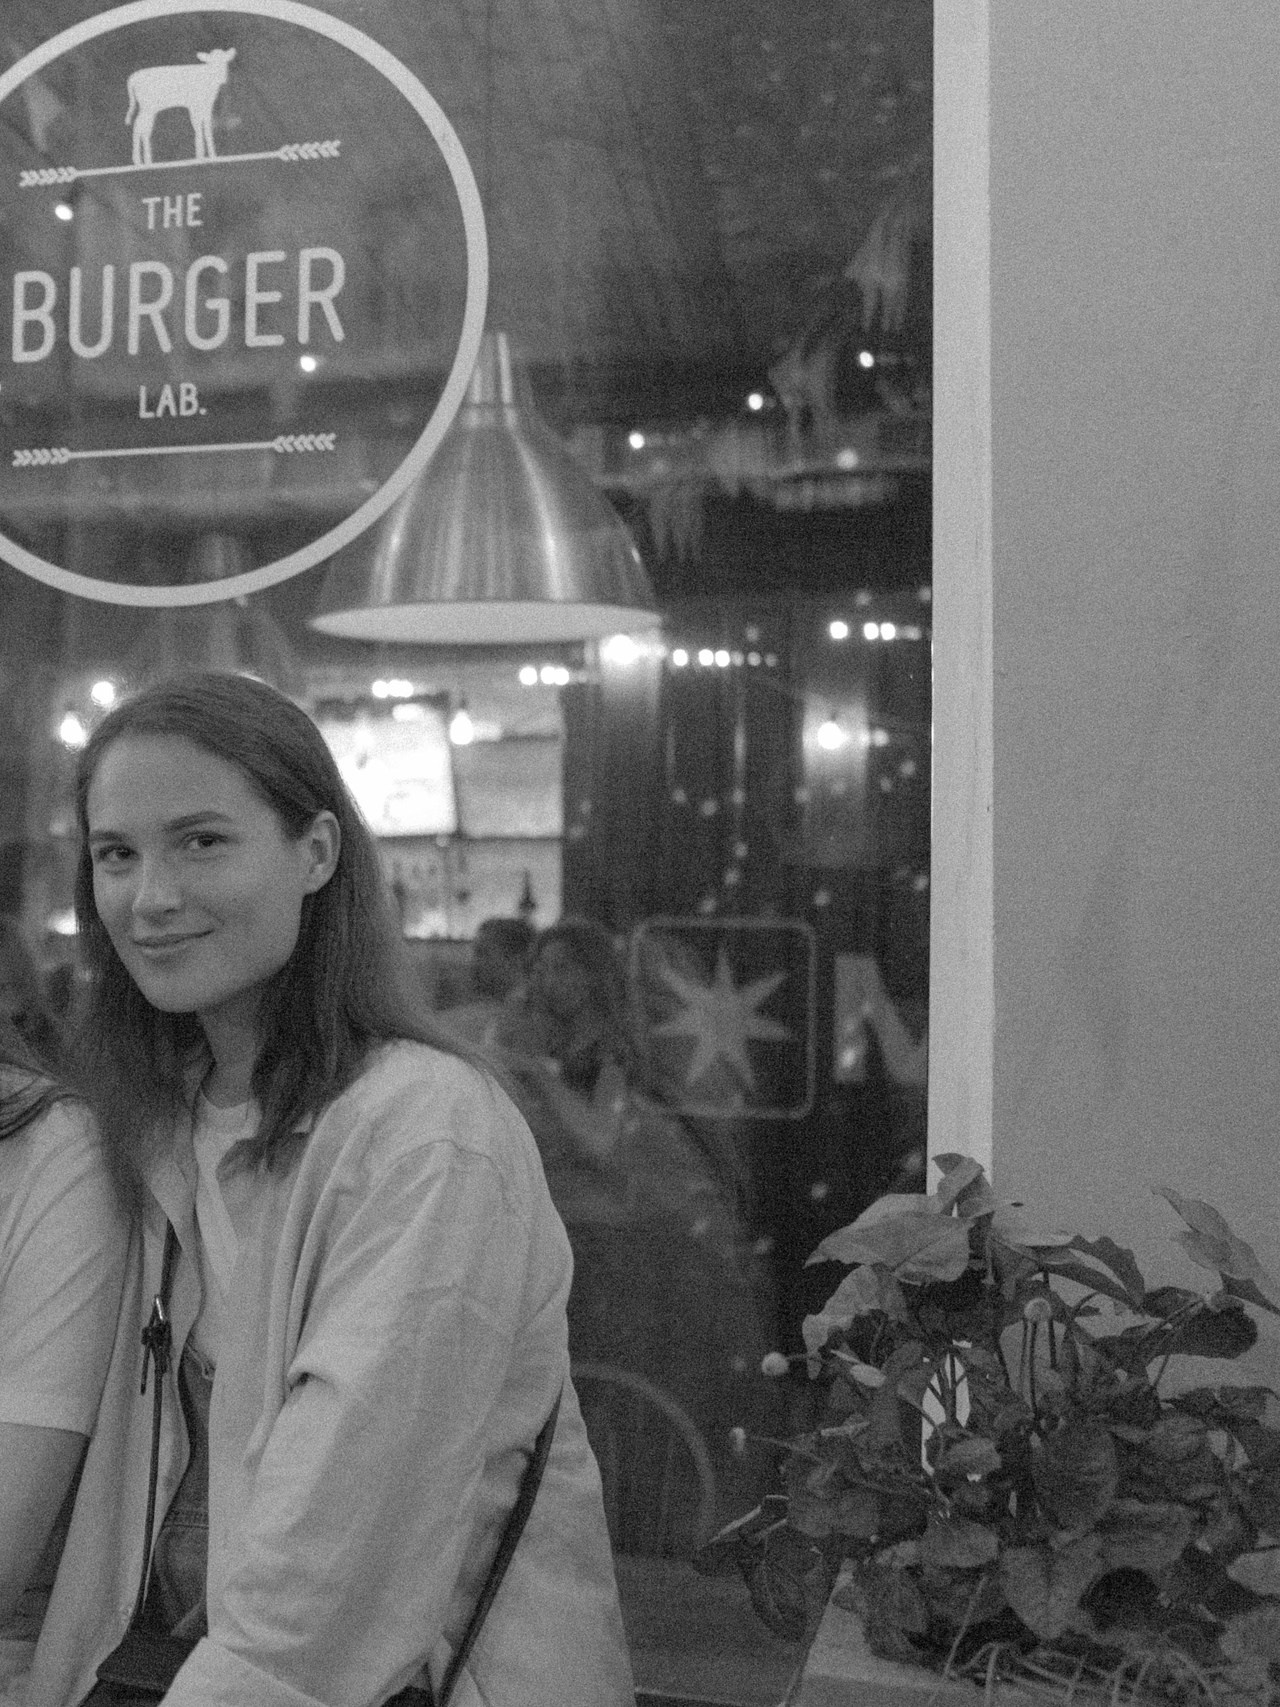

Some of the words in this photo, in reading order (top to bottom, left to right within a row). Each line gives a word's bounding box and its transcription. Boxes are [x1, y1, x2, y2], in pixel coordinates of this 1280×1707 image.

[142, 193, 203, 229] THE
[12, 247, 346, 363] BURGER
[138, 383, 207, 418] LAB.
